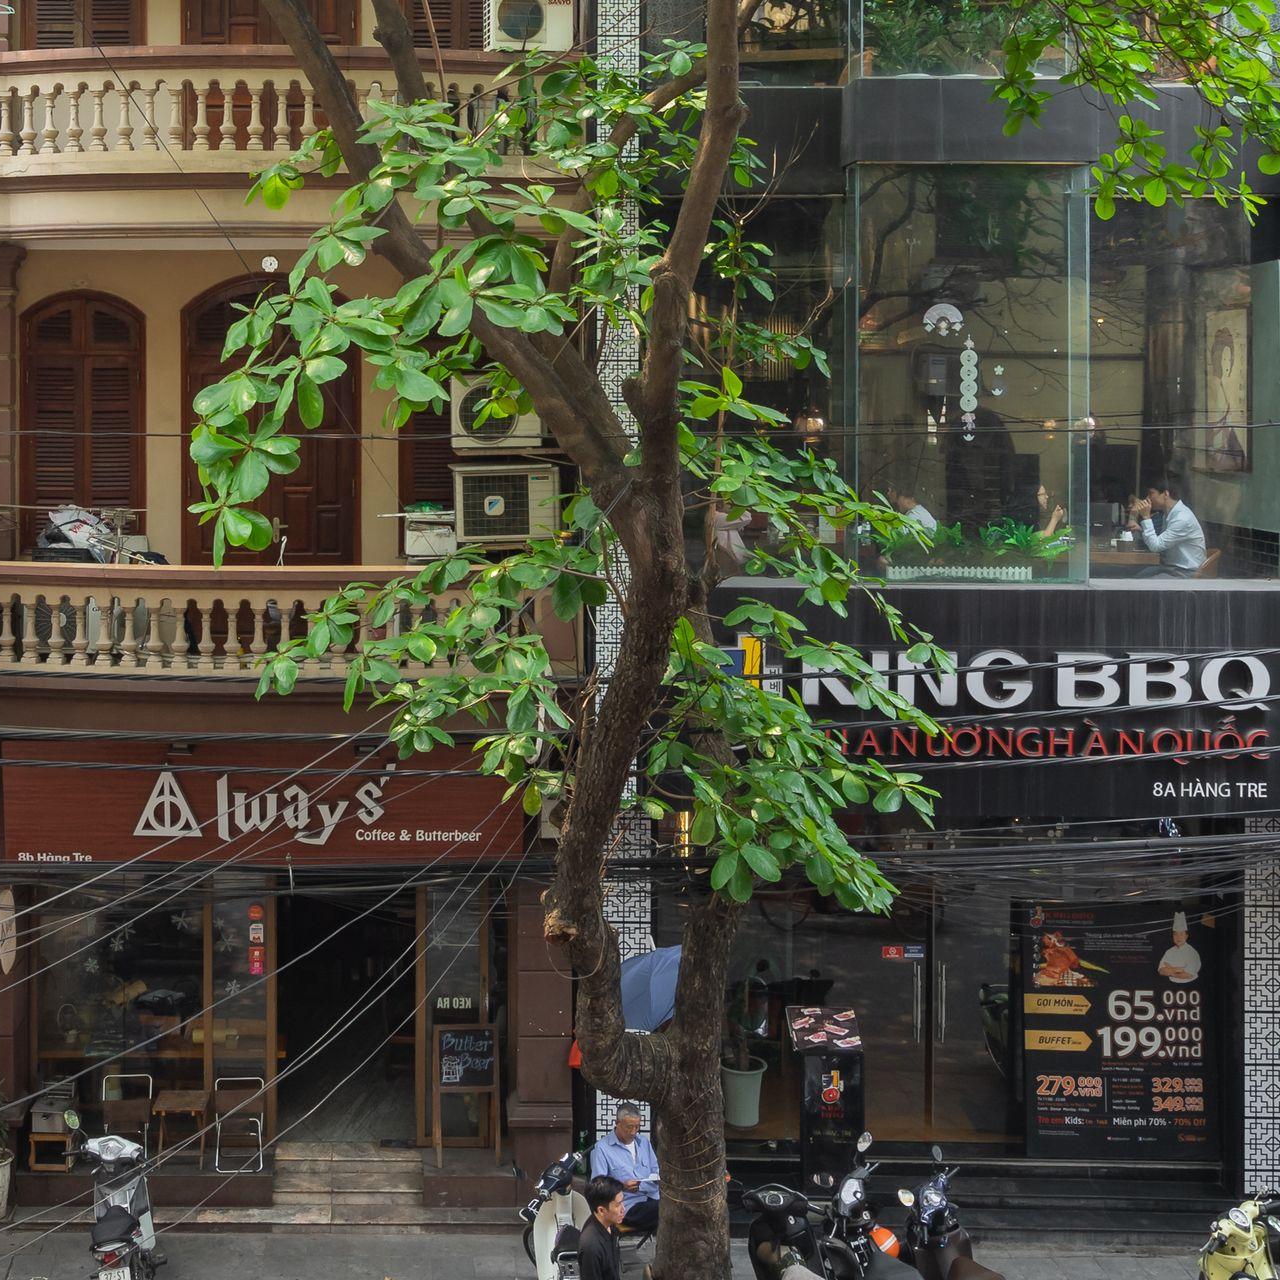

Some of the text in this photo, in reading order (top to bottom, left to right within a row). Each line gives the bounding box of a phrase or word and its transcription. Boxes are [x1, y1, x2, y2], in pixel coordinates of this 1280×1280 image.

[1055, 651, 1271, 711] BBQ
[1152, 778, 1268, 798] 8A HÀNG TRE
[355, 828, 482, 842] Coffee & Butterbeer
[72, 852, 93, 862] Tre
[442, 1033, 492, 1051] Butter
[1038, 1036, 1071, 1045] BUFFET
[461, 1052, 494, 1070] Beer
[1148, 1117, 1167, 1126] 70%
